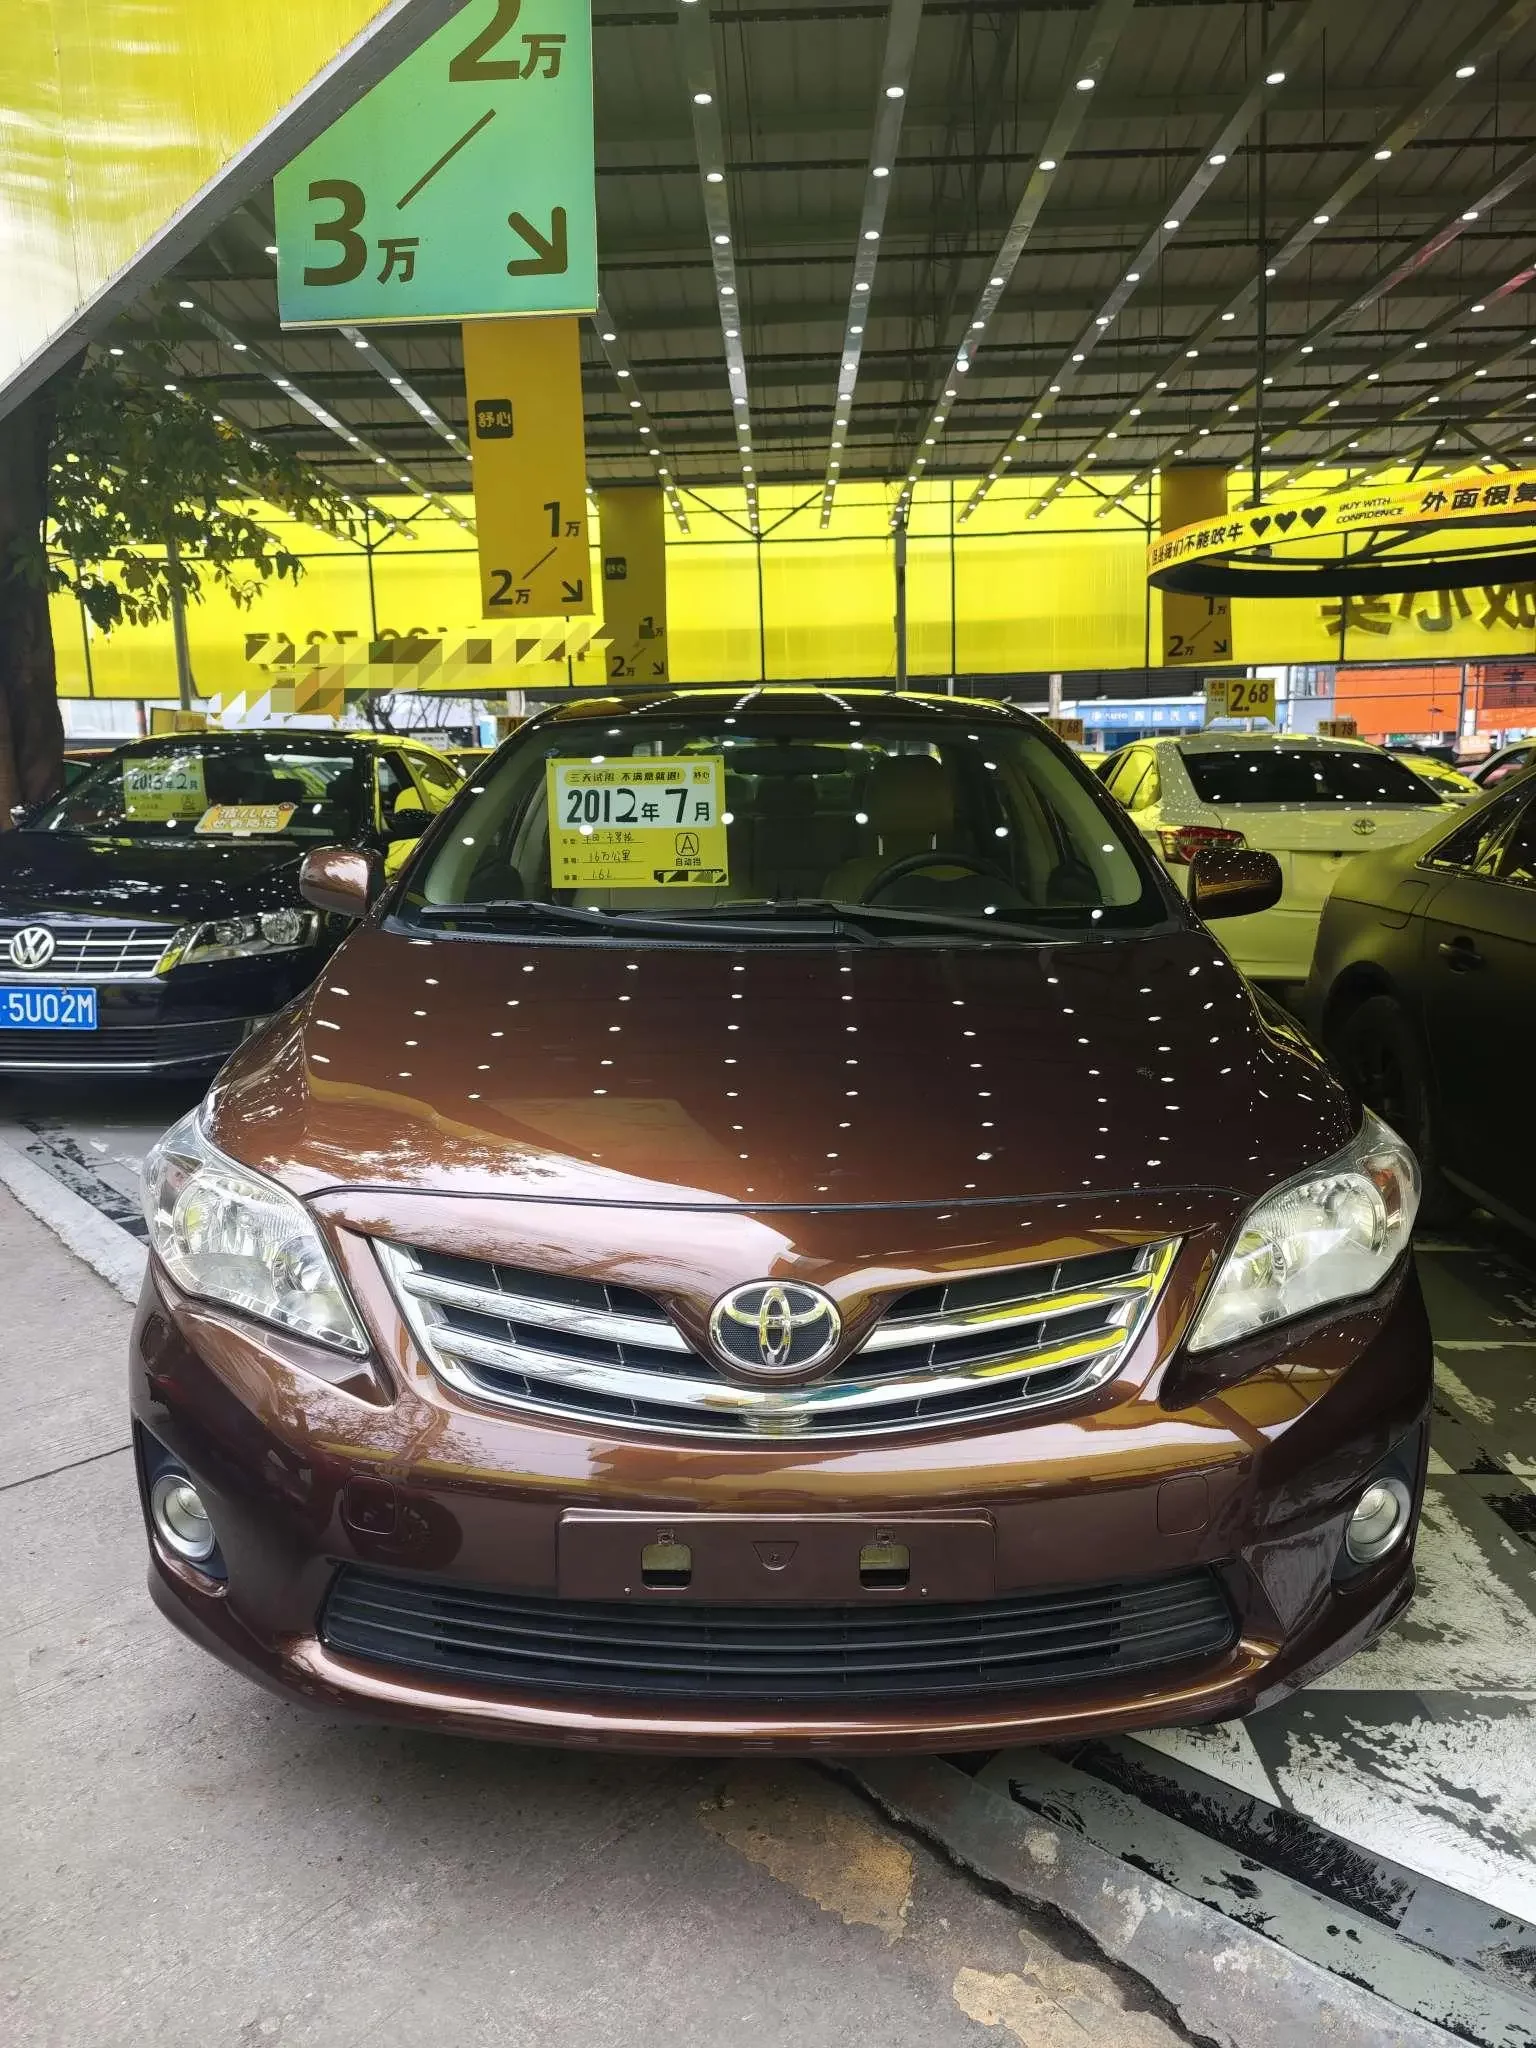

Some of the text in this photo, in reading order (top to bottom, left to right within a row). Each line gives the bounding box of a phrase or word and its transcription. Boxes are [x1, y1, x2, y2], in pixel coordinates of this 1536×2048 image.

[304, 179, 419, 286] 3万
[478, 410, 512, 429] 舒心
[1336, 507, 1404, 525] CONFIDENCE
[1339, 497, 1391, 513] BUY WITH
[543, 501, 581, 538] 1万
[488, 569, 531, 606] 2万
[1168, 635, 1195, 657] 2万
[610, 655, 636, 677] 2万
[681, 835, 695, 854] A
